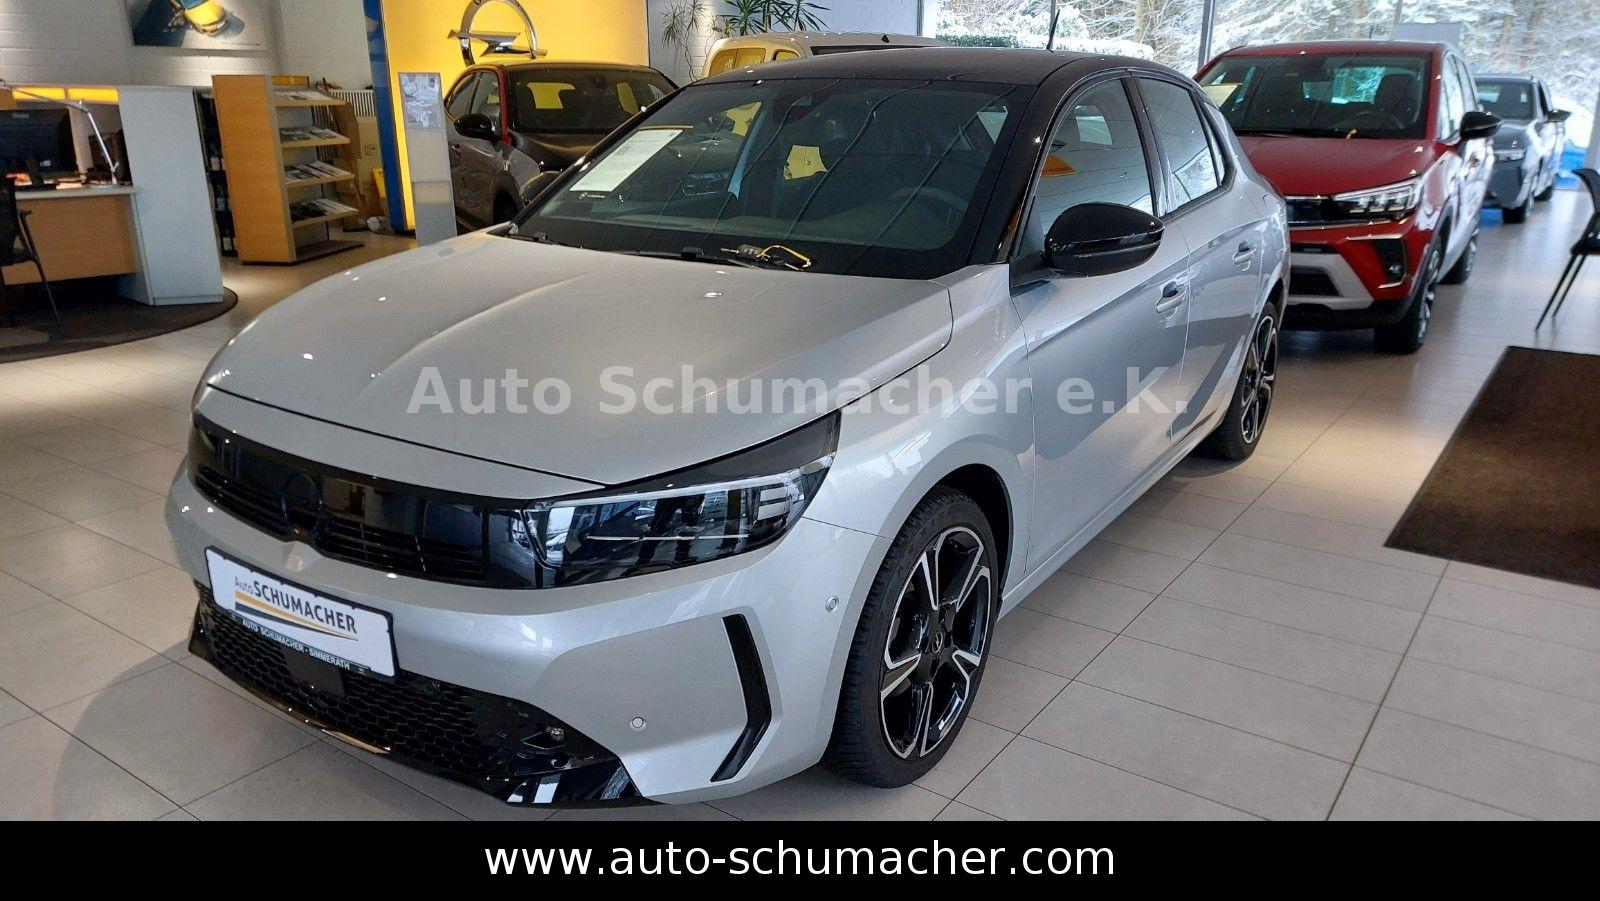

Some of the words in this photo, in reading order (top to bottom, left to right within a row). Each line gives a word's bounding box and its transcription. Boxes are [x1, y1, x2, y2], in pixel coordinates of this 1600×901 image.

[254, 580, 357, 634] SCHUMACHER
[243, 619, 259, 632] AUTO
[260, 626, 305, 653] SCHUMACHER
[309, 648, 351, 670] SIMMERATH
